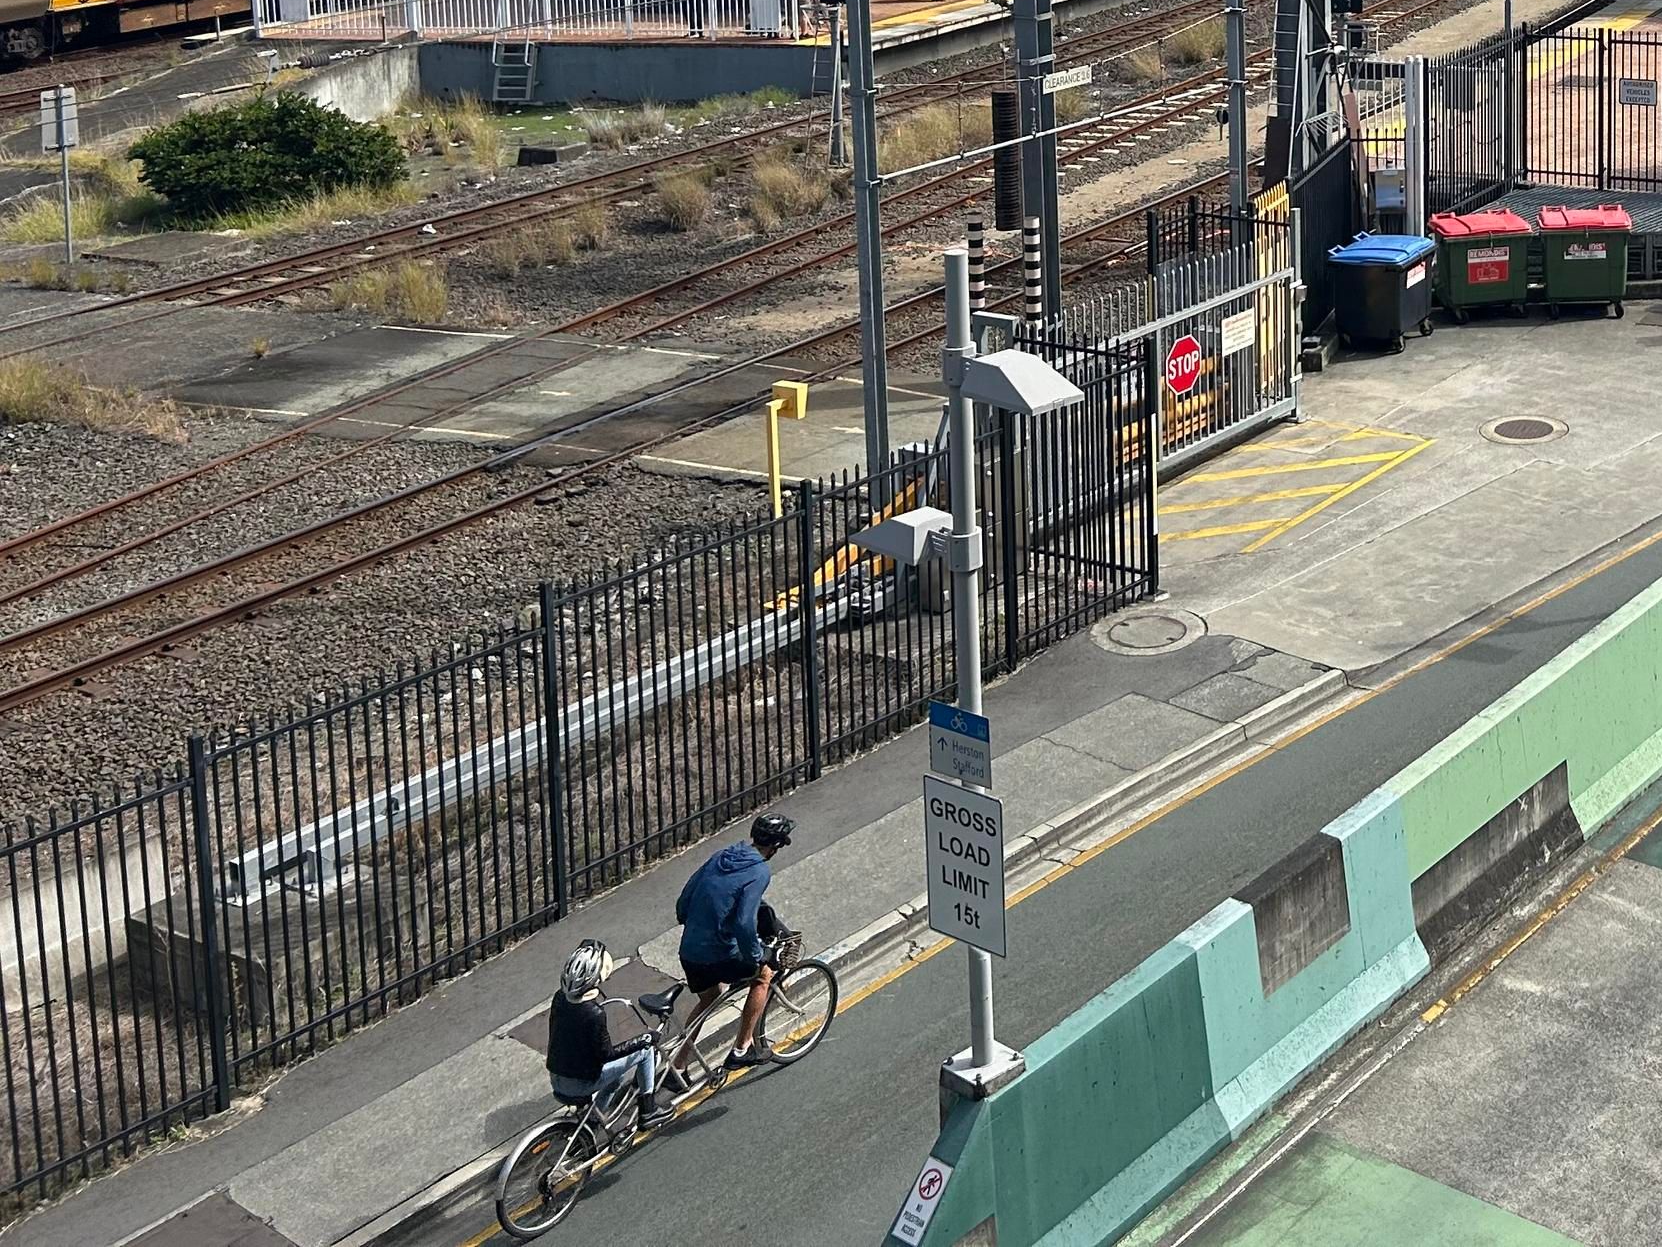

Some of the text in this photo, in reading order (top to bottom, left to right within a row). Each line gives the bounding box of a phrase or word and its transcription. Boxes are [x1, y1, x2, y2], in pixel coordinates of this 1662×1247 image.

[1168, 350, 1199, 381] STOP
[952, 739, 985, 762] Herston
[952, 757, 985, 778] Stafford
[930, 797, 997, 837] GROSS
[939, 831, 991, 867] LOAD
[942, 864, 990, 900] LIMIT
[954, 902, 981, 930] 15t
